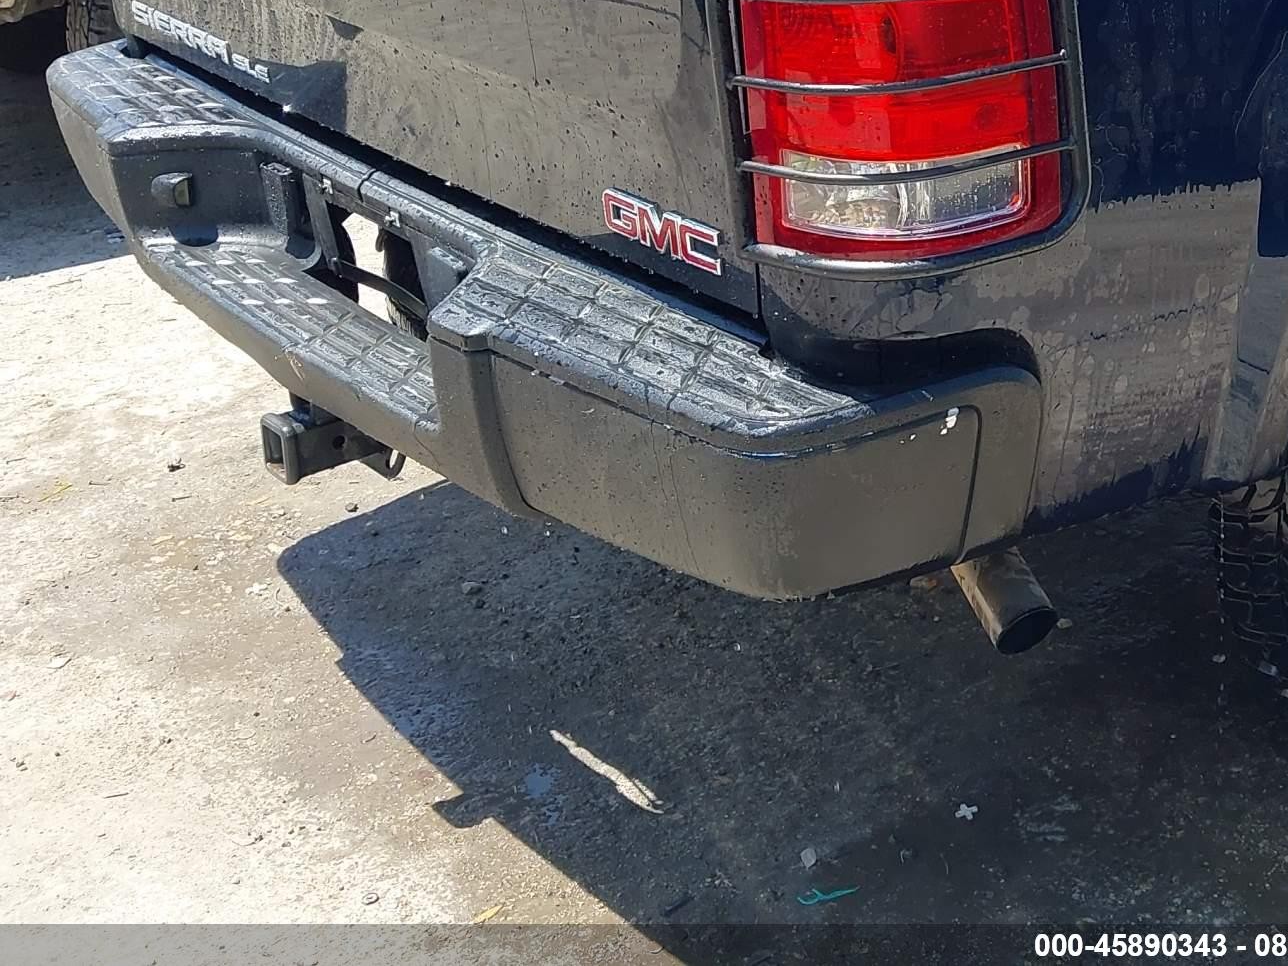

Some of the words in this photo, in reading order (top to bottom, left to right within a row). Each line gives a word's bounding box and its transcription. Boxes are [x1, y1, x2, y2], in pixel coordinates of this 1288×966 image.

[131, 0, 232, 65] SIERRA
[231, 53, 271, 84] SLE
[602, 187, 721, 276] GMC
